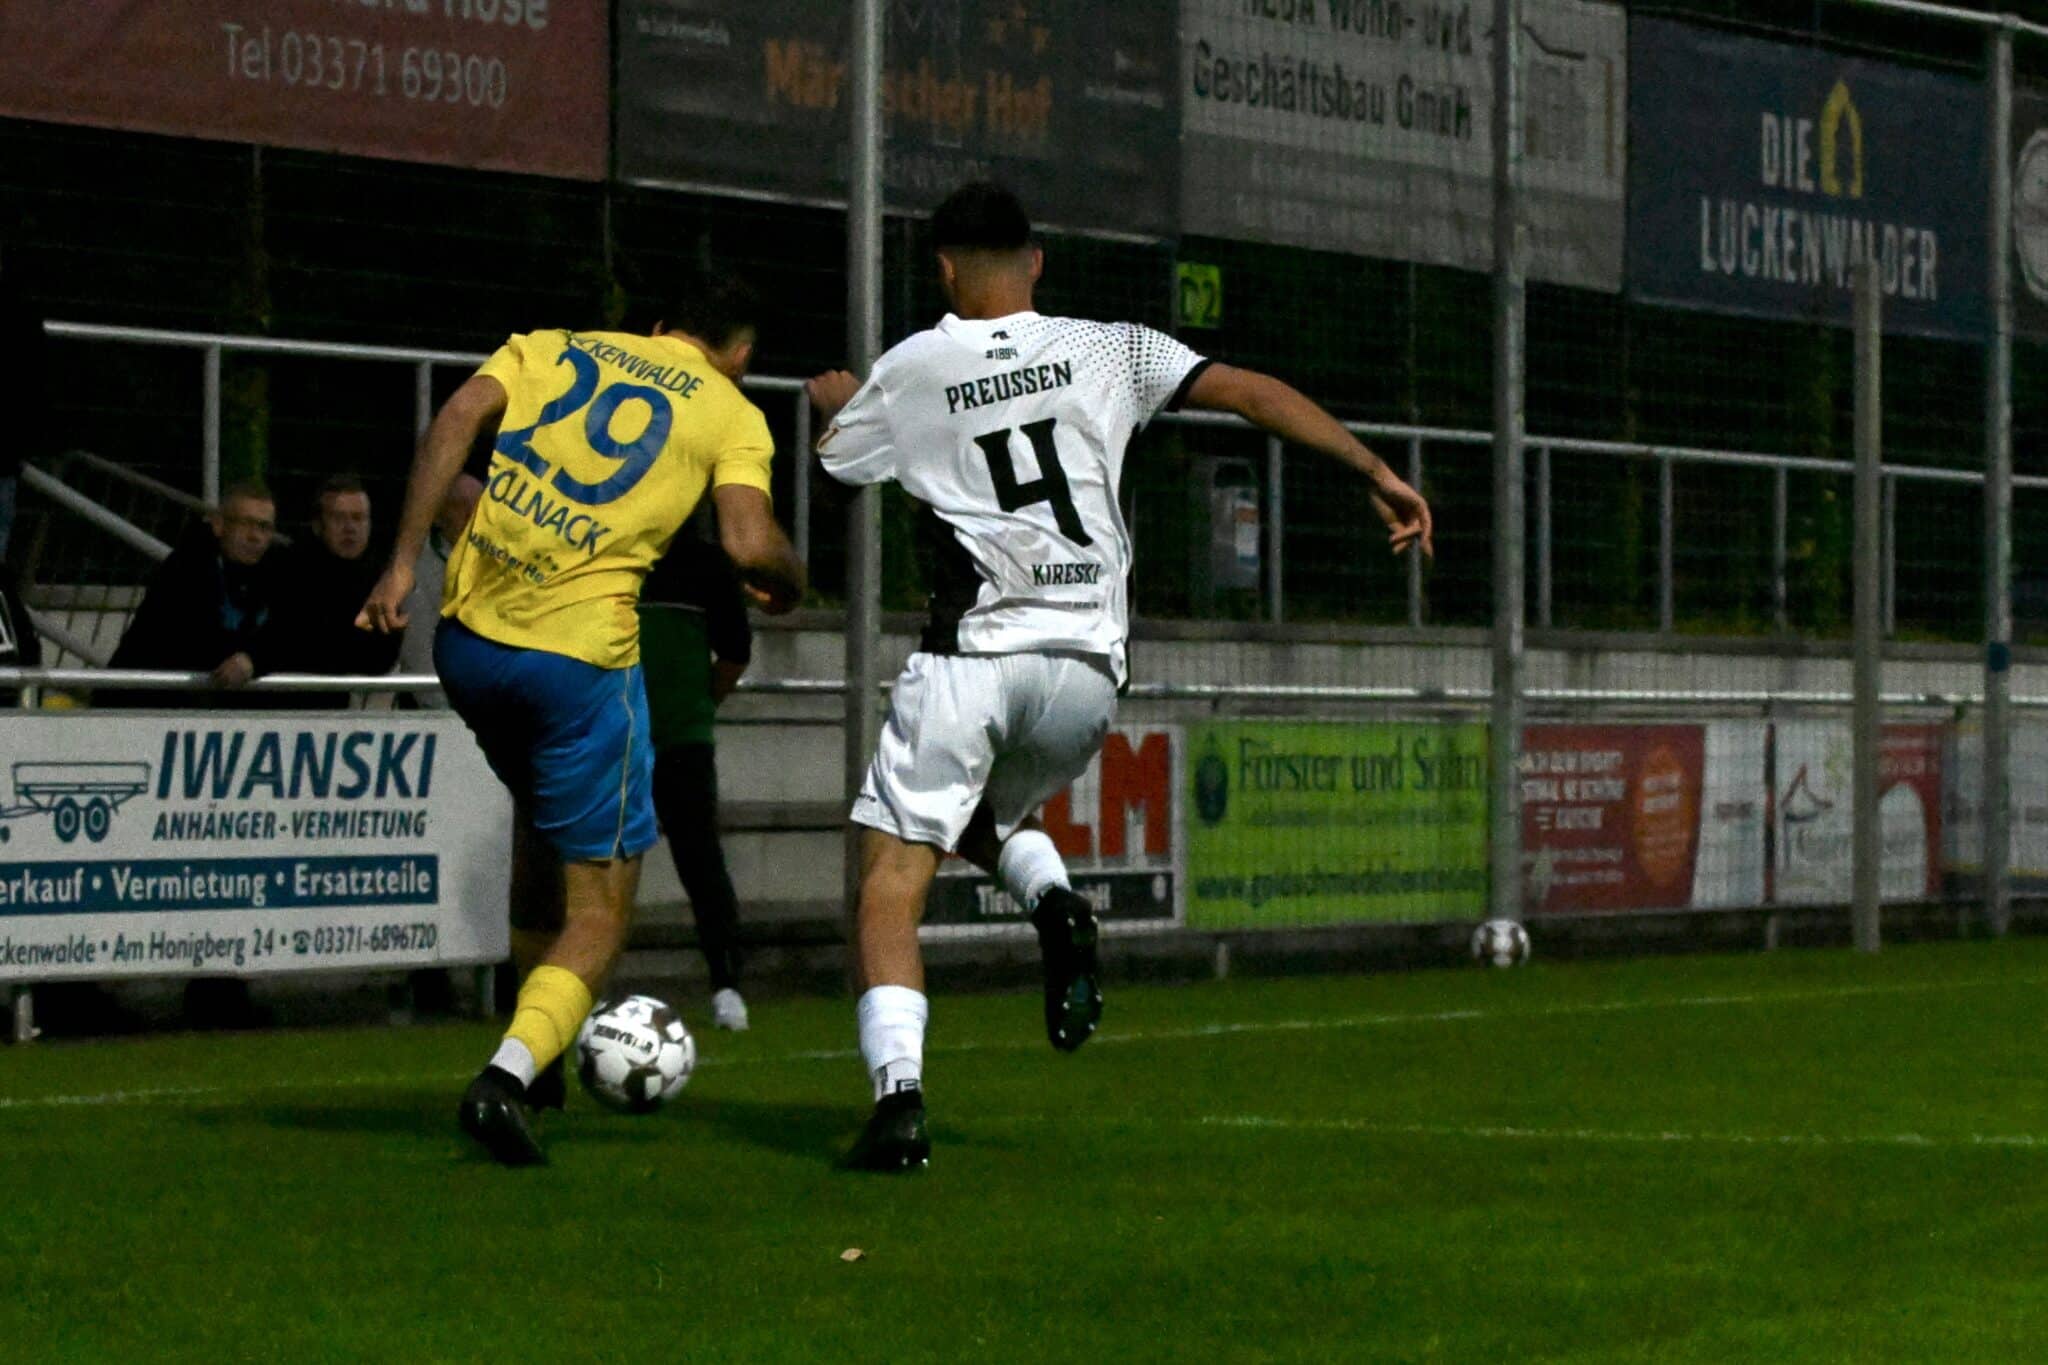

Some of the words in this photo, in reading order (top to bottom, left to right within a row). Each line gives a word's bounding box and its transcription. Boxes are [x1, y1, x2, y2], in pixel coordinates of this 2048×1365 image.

[220, 23, 271, 79] Tel
[279, 31, 387, 96] 03371
[401, 46, 507, 108] 69300
[1193, 38, 1385, 125] Geschäftsbau
[1396, 72, 1472, 140] GmbH
[1761, 111, 1815, 194] DIE
[1701, 196, 1938, 301] LUCKENWALDER
[494, 344, 674, 506] 29
[945, 360, 1073, 415] PREUSSEN
[973, 417, 1094, 548] 4
[1032, 563, 1101, 587] KIRESKI
[157, 730, 437, 800] IWANSKI
[111, 865, 267, 907] Vermietung
[294, 859, 433, 897] Ersatzteile
[112, 932, 144, 962] Am
[150, 930, 246, 967] Honigberg
[253, 928, 274, 957] 24
